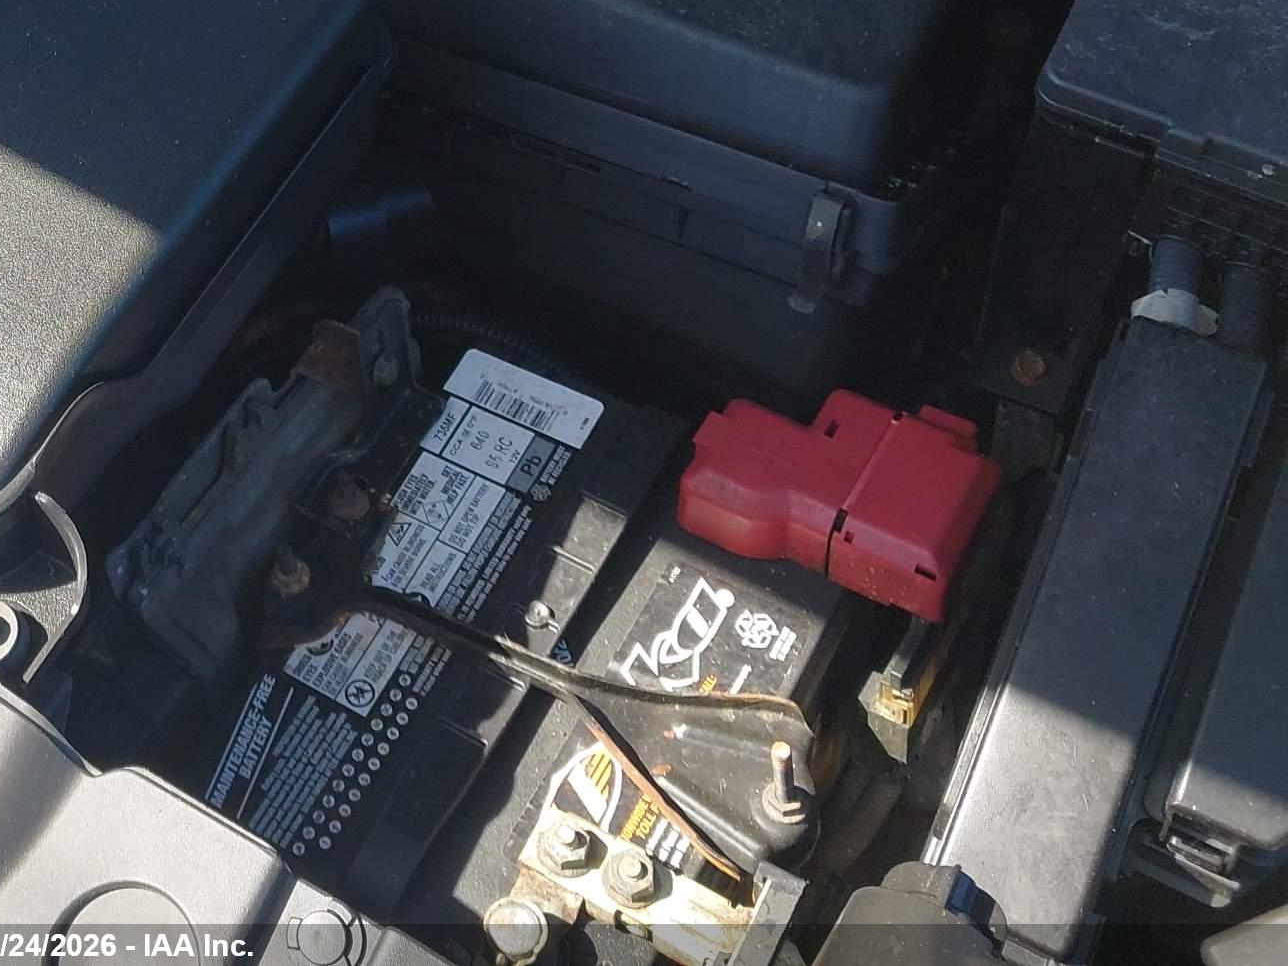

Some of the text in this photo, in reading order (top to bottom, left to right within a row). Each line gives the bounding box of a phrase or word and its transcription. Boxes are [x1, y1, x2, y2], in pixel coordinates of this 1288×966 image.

[470, 430, 490, 450] 640
[493, 436, 514, 454] RC
[518, 453, 543, 476] Pb
[210, 672, 276, 808] MAINTENANCE-FREE
[237, 714, 273, 779] BATTERY
[634, 809, 657, 840] TOLL
